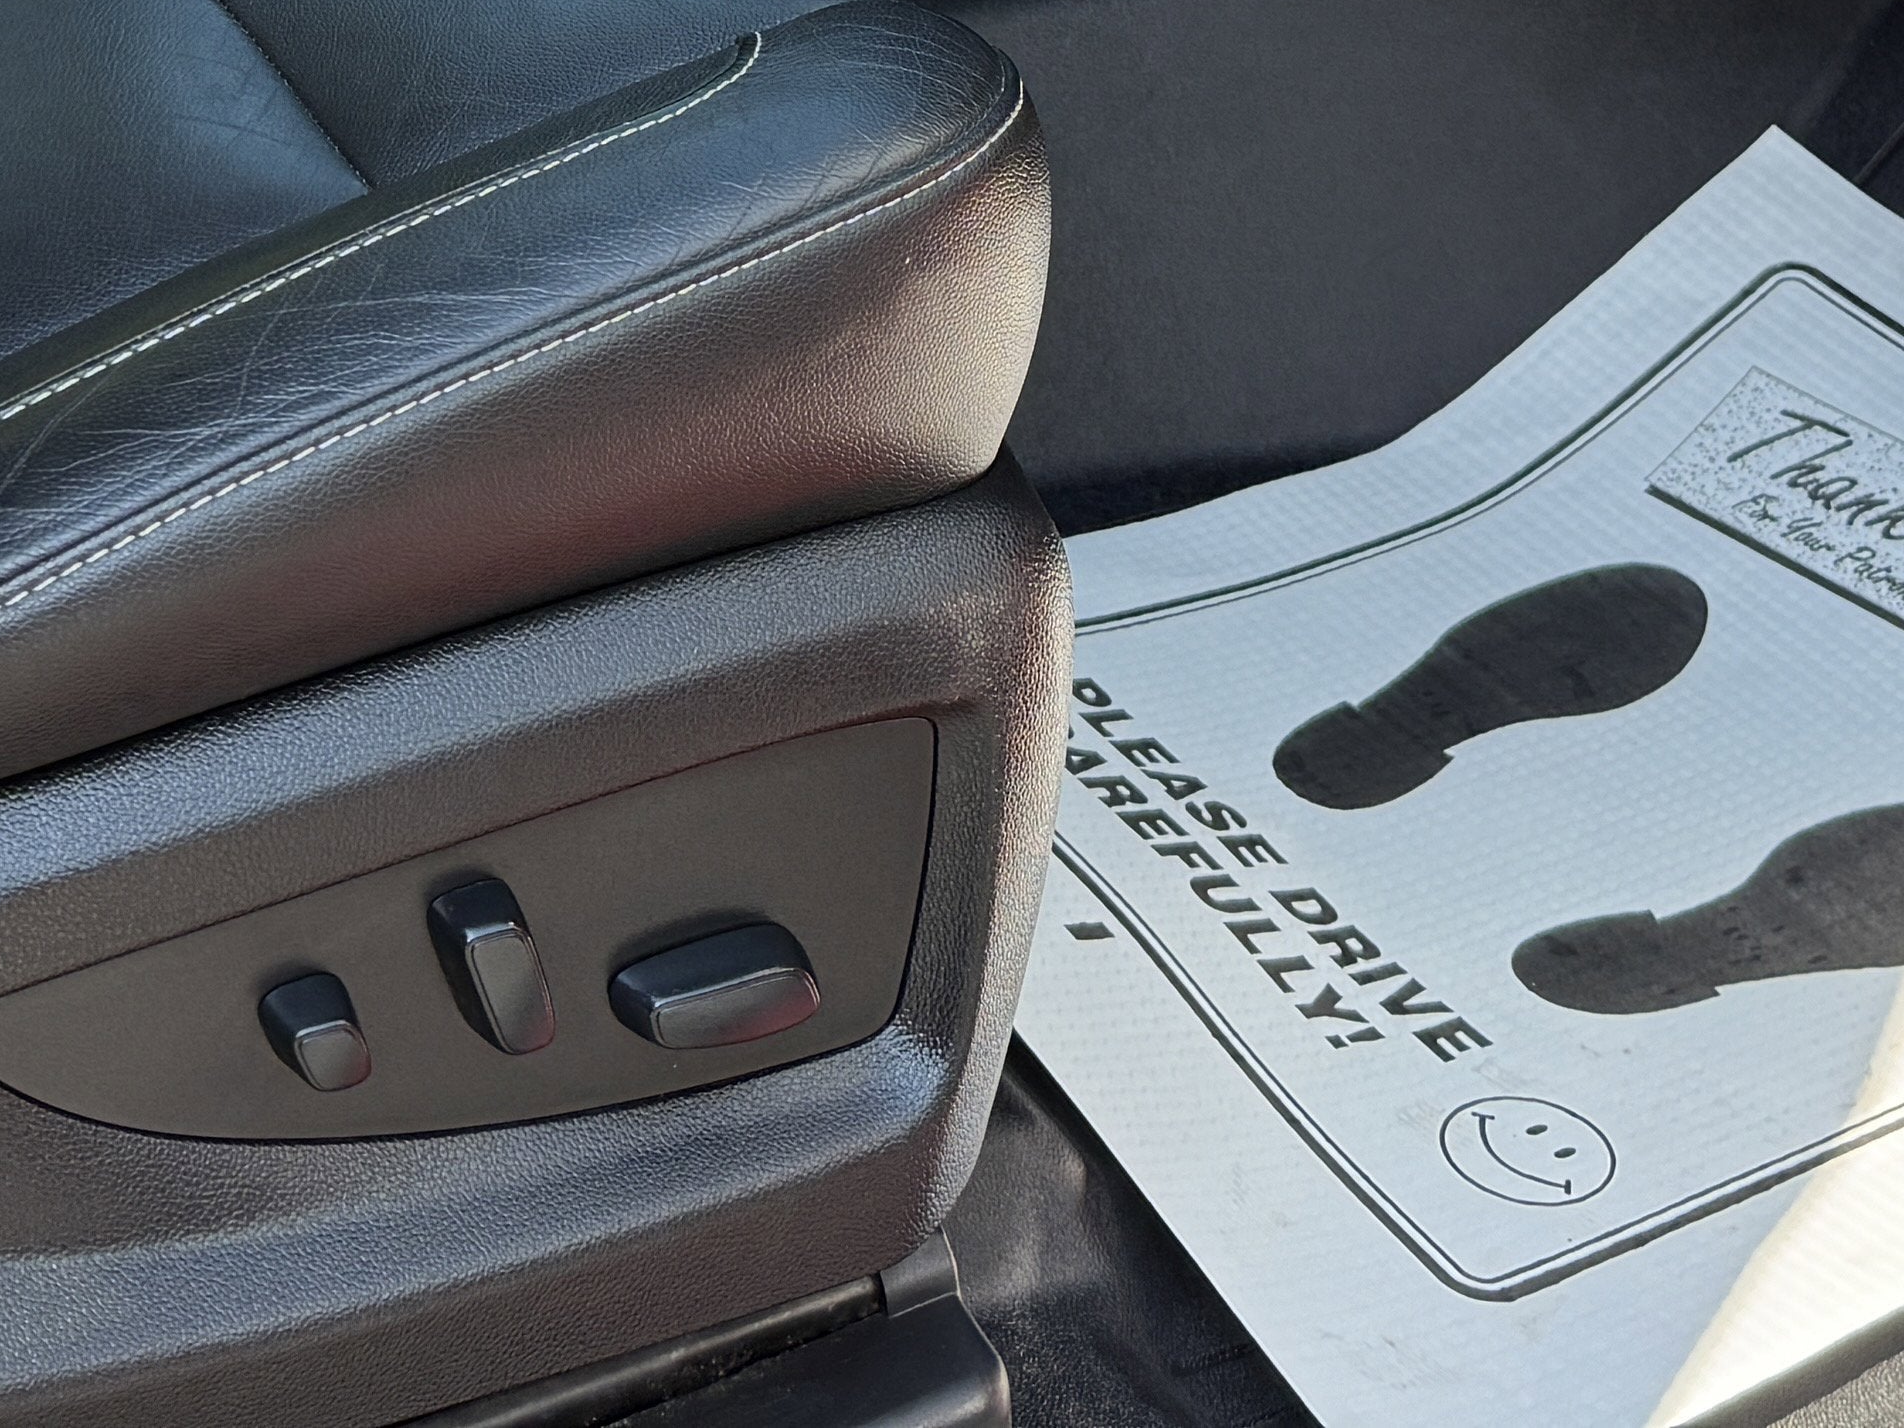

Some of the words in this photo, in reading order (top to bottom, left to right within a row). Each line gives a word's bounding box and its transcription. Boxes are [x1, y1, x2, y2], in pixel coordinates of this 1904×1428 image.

[1732, 492, 1778, 524] For
[1779, 516, 1836, 553] Your
[1065, 726, 1386, 1050] AREFULLY!
[1072, 677, 1289, 868] PLEASE
[1269, 886, 1494, 1063] DRIVE
